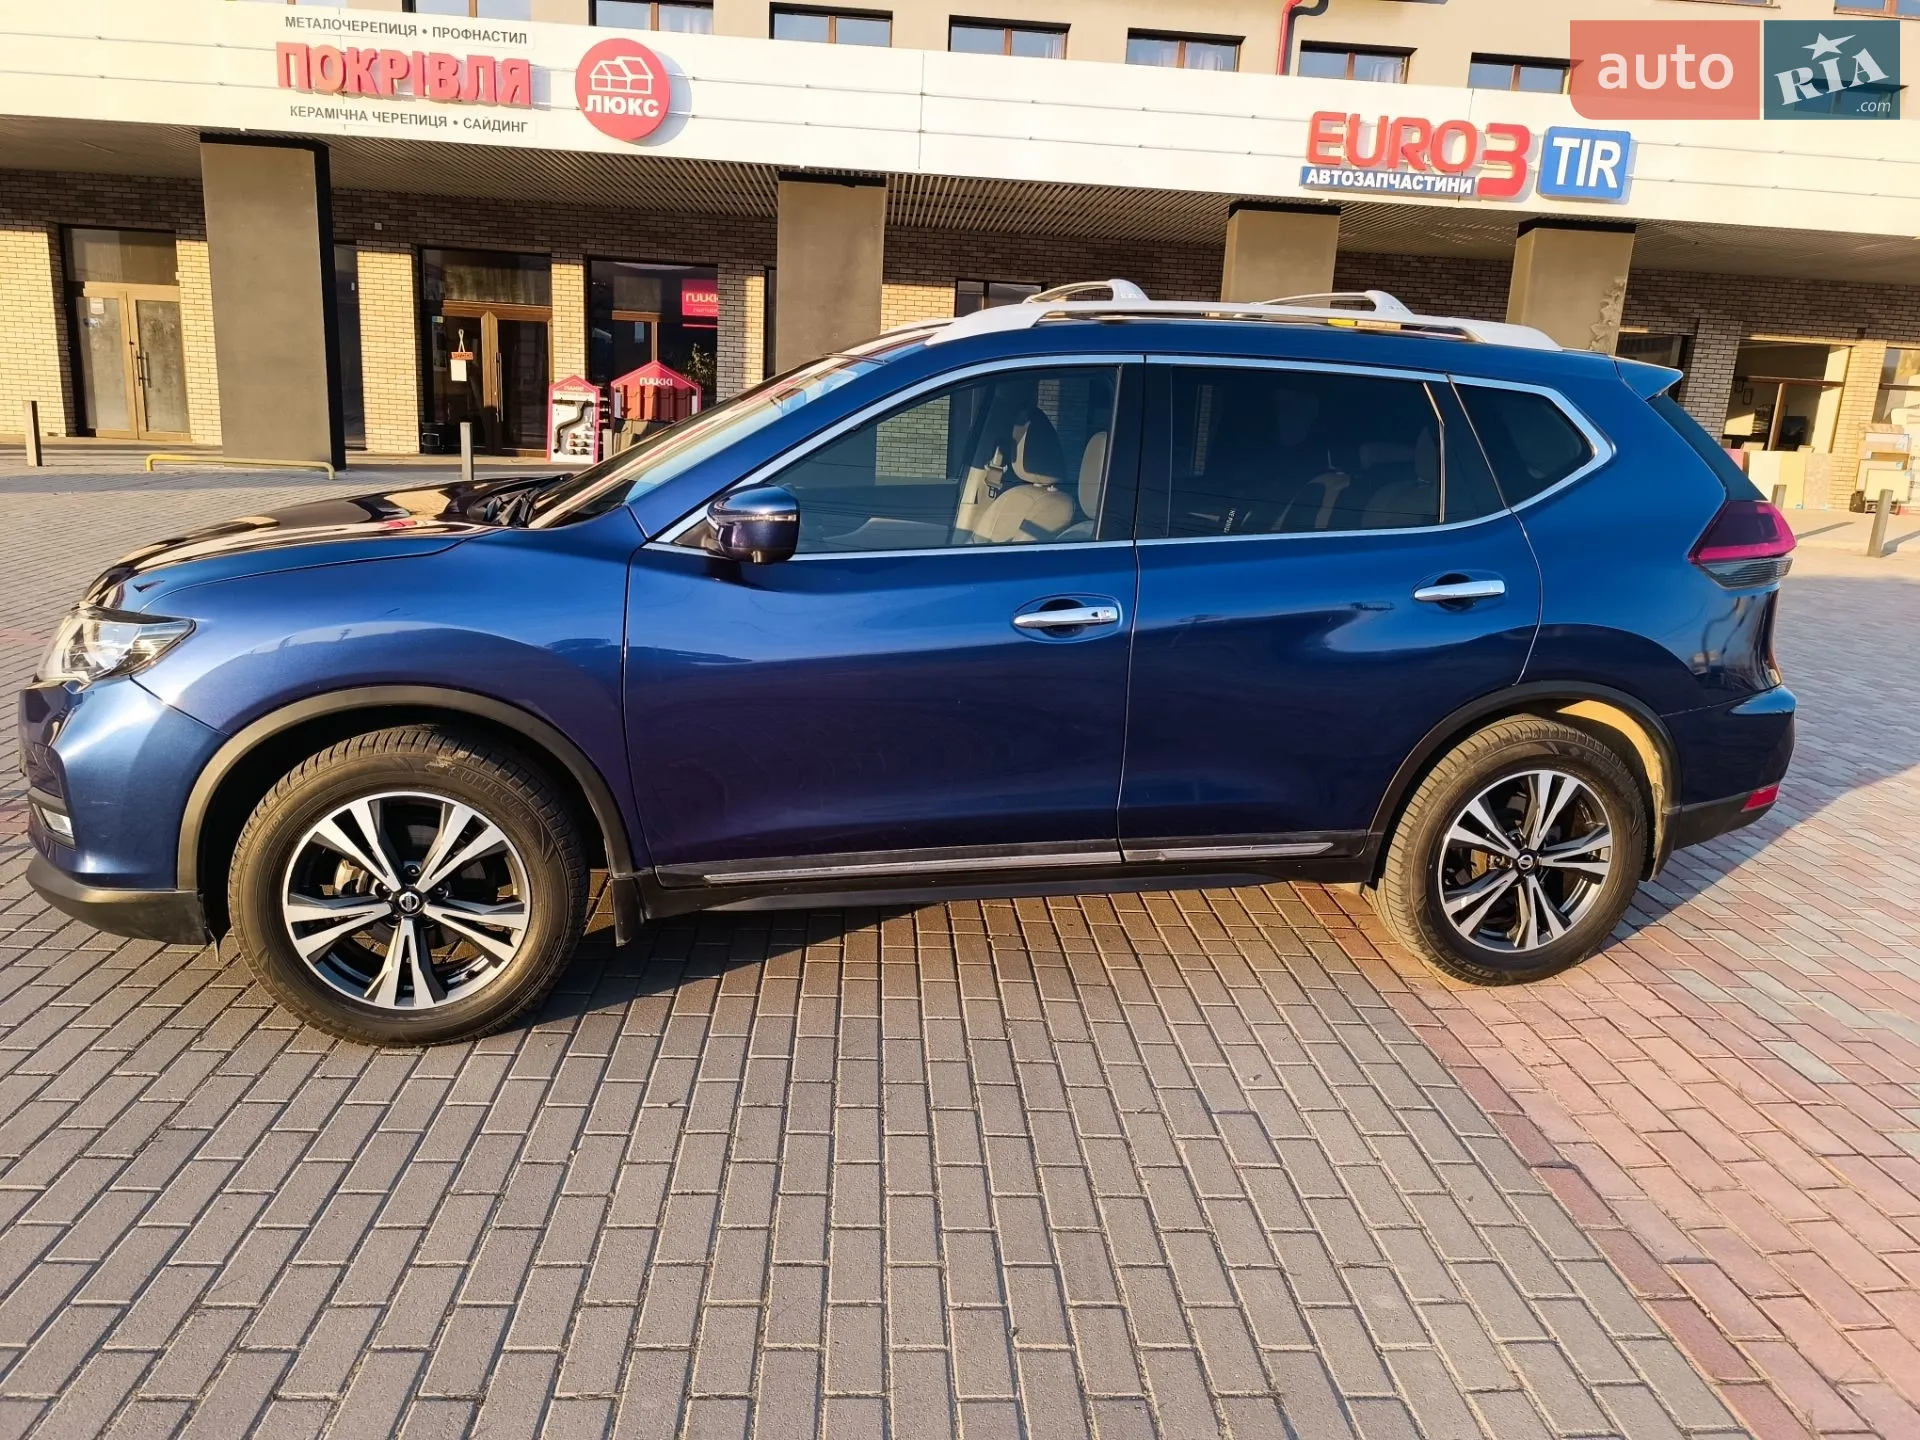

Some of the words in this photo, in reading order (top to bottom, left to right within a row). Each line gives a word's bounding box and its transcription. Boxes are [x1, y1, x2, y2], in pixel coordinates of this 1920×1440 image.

[285, 16, 418, 37] МЕТАЛОЧЕРЕПИЦЯ
[432, 27, 528, 45] ПРОФНАСТИЛ
[276, 42, 532, 107] ПОКРІВЛЯ
[290, 105, 369, 122] КЕРАМІЧНА
[372, 111, 448, 128] ЧЕРЕПИЦЯ
[463, 118, 528, 133] САЙДИНГ
[586, 95, 660, 118] ЛЮКС
[1552, 136, 1622, 189] TIR
[1306, 168, 1474, 194] АВТОЗАПЧАСТИНИ
[685, 292, 718, 303] ruuk
